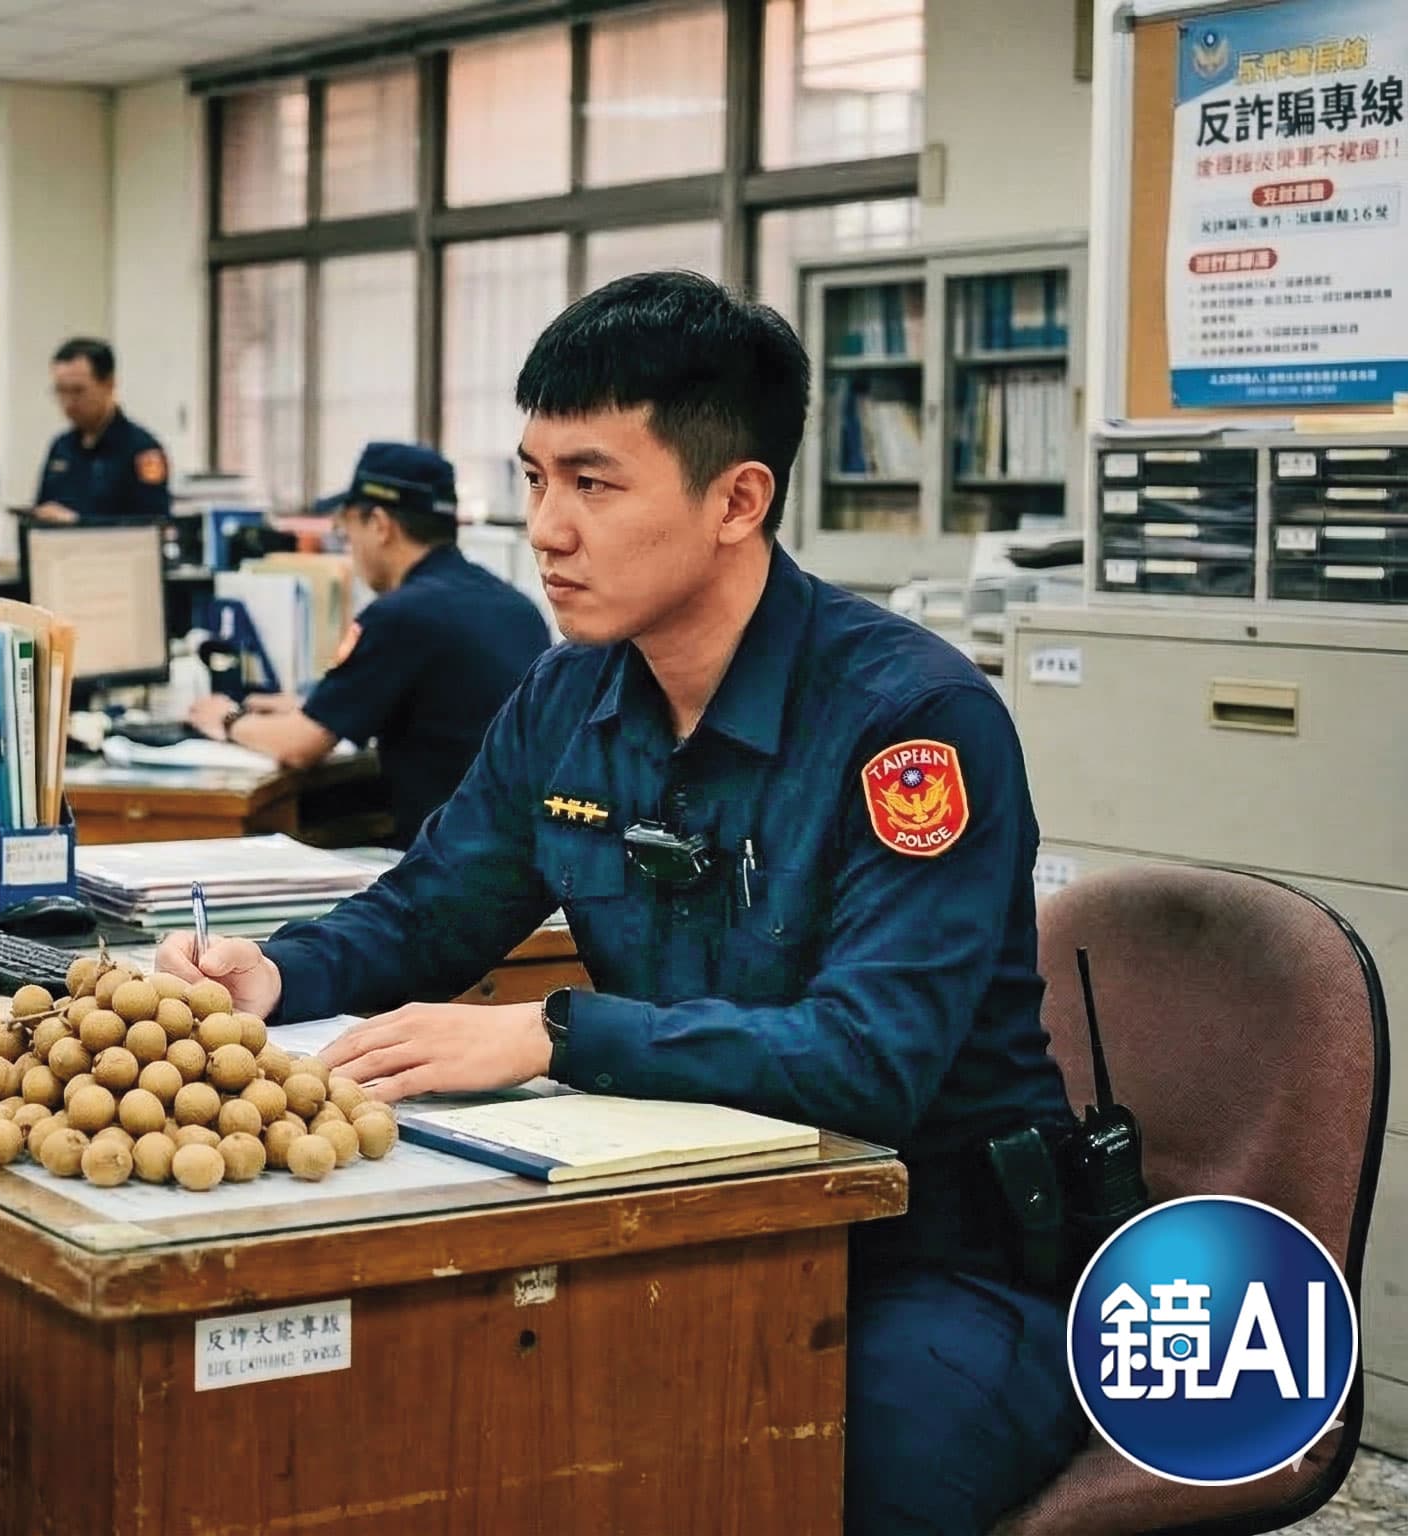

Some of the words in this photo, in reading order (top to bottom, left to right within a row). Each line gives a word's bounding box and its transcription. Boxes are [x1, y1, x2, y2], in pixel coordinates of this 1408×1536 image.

[1197, 75, 1404, 147] 反詐騙專線
[894, 826, 952, 847] POLICE
